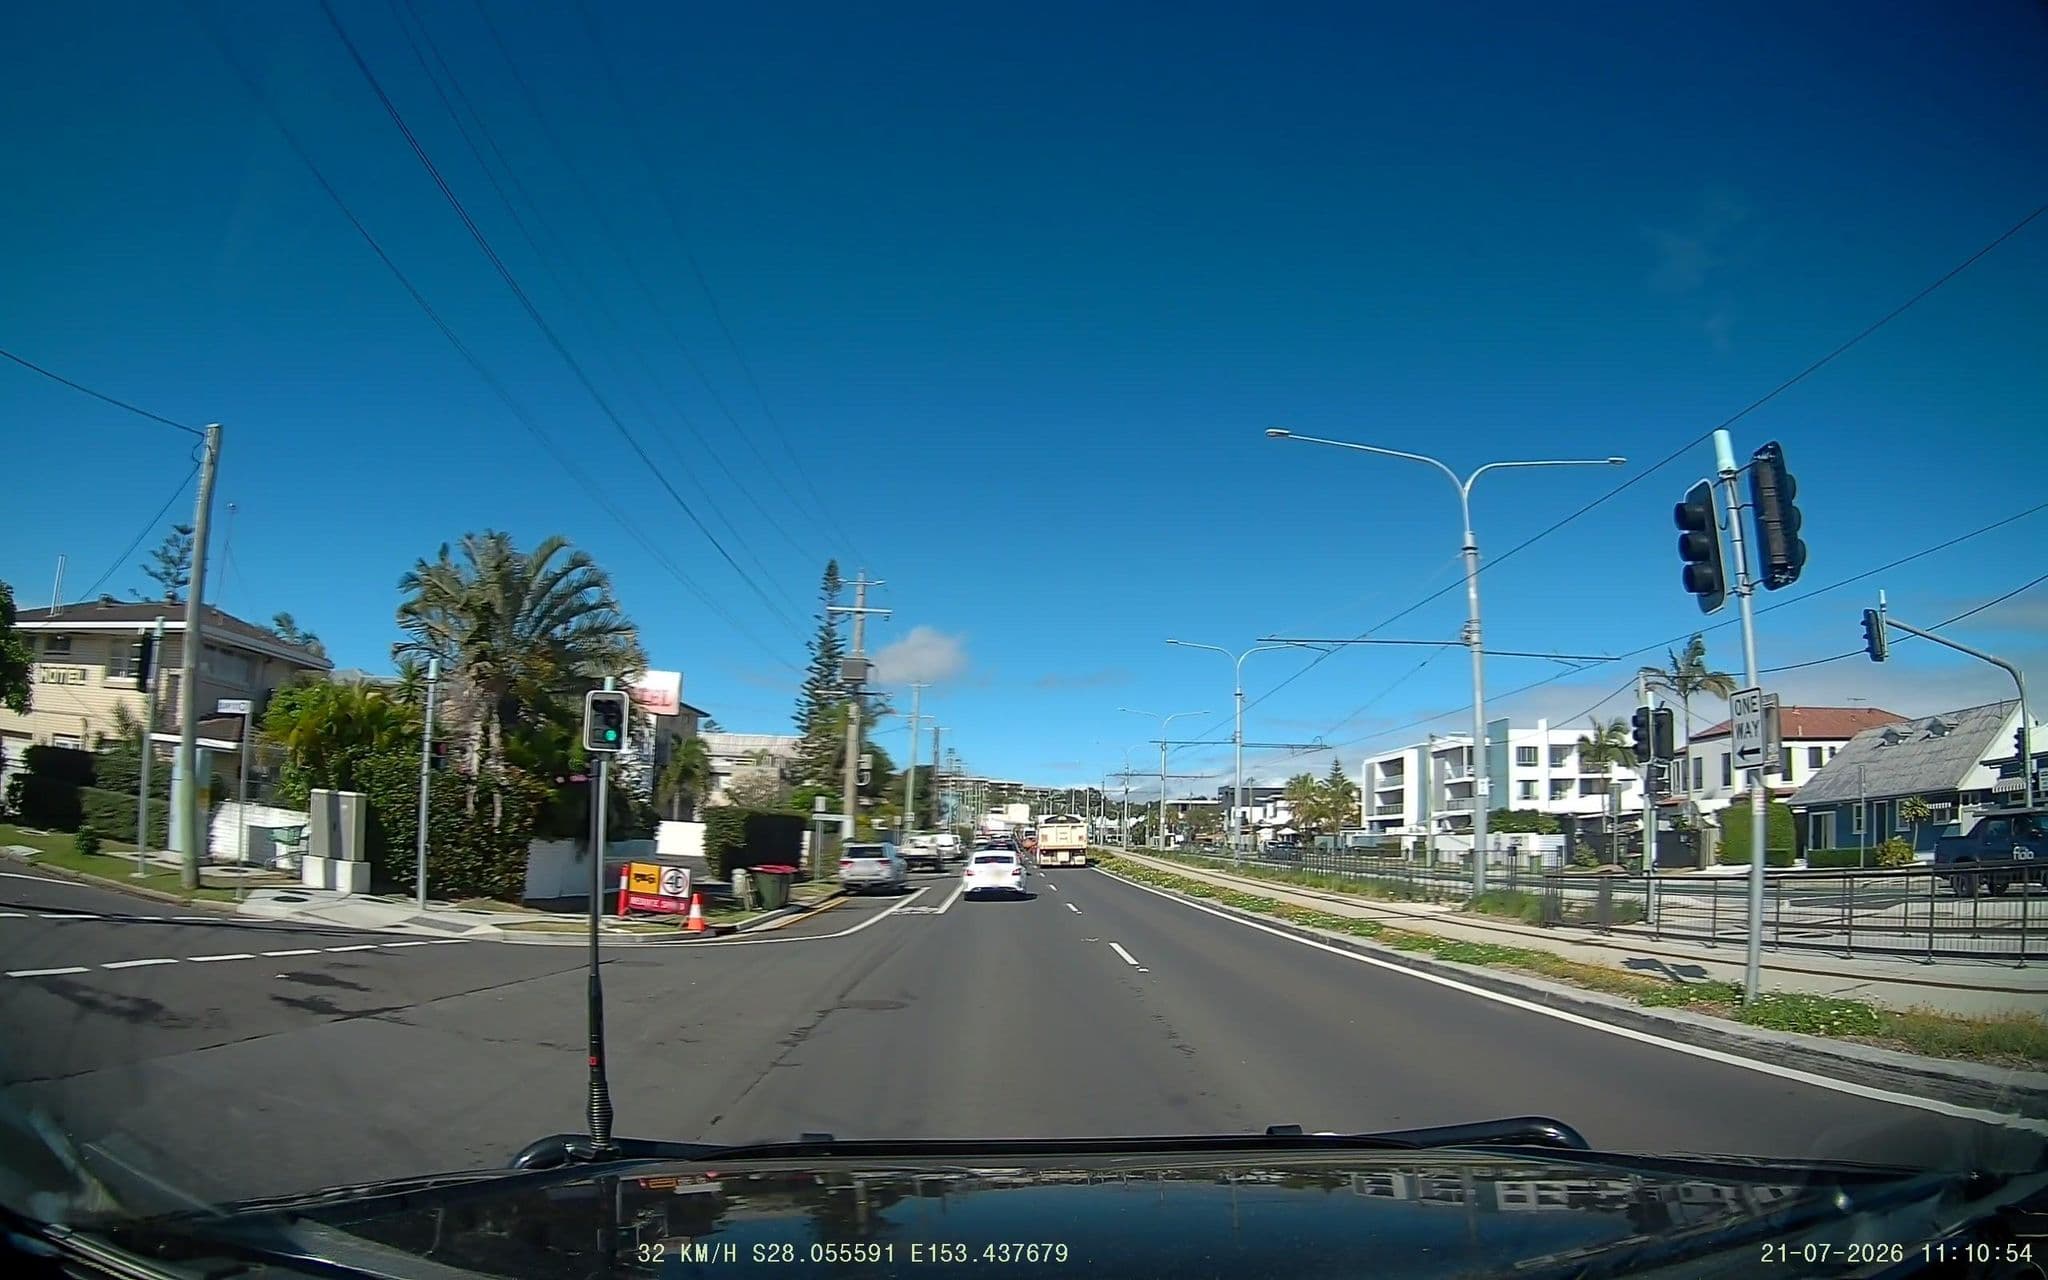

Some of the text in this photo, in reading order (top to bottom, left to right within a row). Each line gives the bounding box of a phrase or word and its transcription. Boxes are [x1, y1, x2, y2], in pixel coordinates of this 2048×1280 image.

[1734, 695, 1759, 716] ONE
[1735, 719, 1760, 740] WAY
[664, 872, 684, 892] 40
